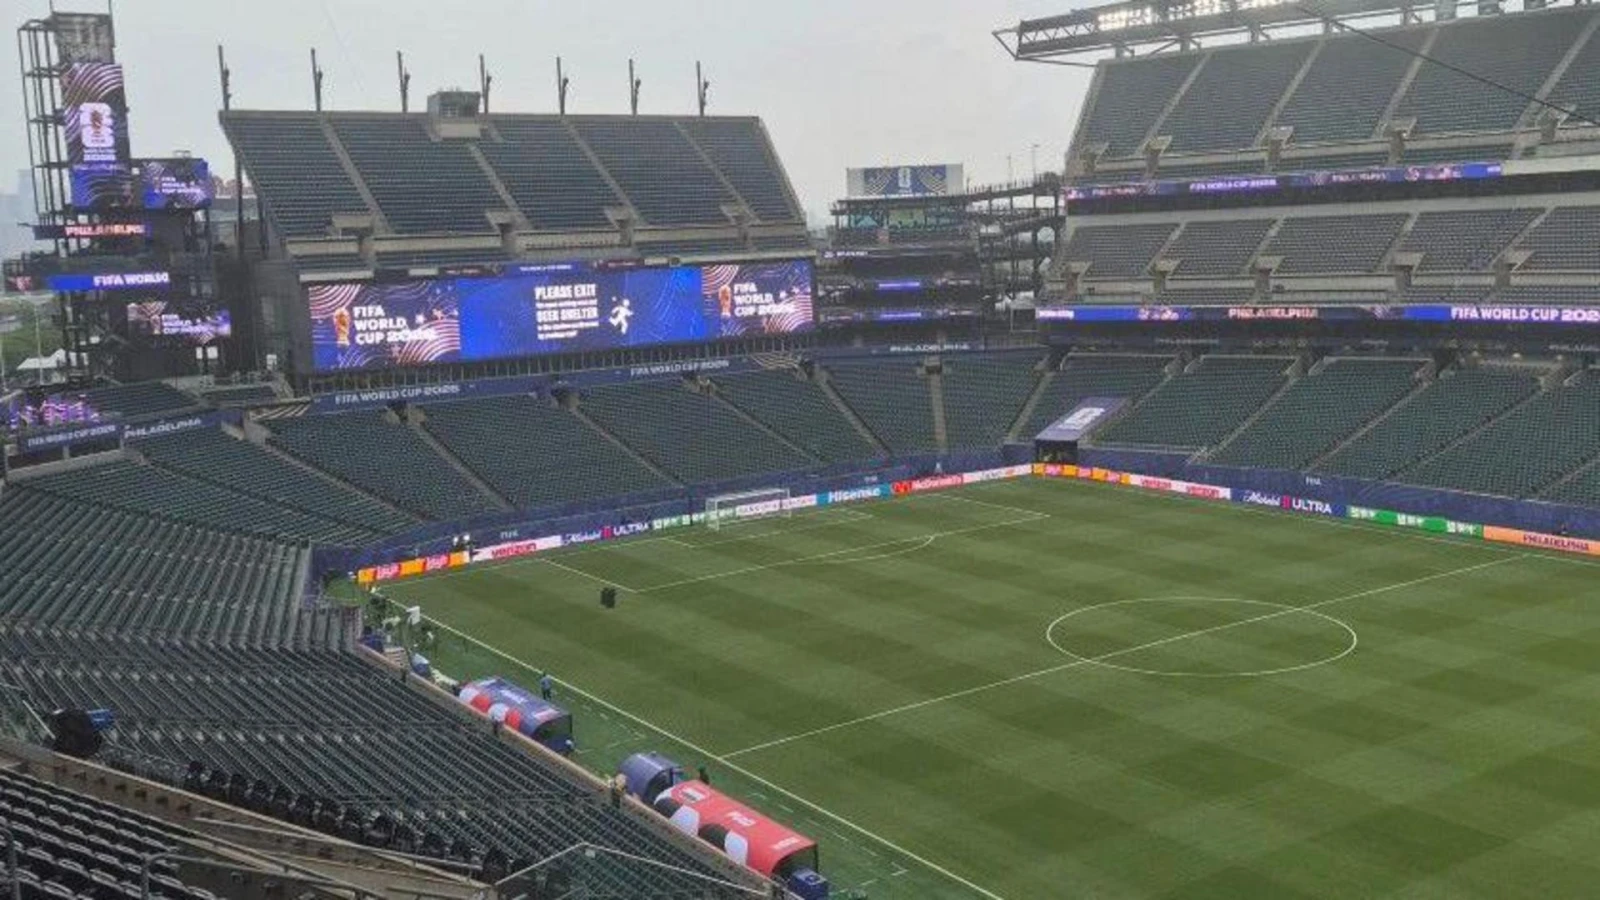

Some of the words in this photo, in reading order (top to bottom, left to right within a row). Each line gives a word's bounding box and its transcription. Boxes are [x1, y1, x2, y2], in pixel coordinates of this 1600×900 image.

[93, 275, 124, 286] FIFA
[534, 285, 573, 300] PLEASE
[574, 284, 596, 298] EXIT
[734, 282, 757, 294] FIFA
[734, 292, 773, 305] WORLD
[353, 305, 385, 318] FIFA
[734, 305, 756, 317] CUP
[1450, 307, 1479, 320] FIFA
[1480, 308, 1529, 321] WORLD
[1531, 308, 1559, 321] CUP
[354, 317, 407, 331] WORLD
[355, 331, 385, 345] CUP
[650, 363, 681, 375] WORLD
[334, 393, 359, 405] FIFA
[360, 390, 399, 402] WORLD
[400, 387, 422, 398] CUP
[124, 418, 201, 438] PHILADELPHIA
[828, 486, 881, 503] Hisense
[1292, 498, 1332, 514] ULTRA
[613, 522, 649, 536] ULTRA
[1523, 534, 1589, 551] PHILADELPHIA
